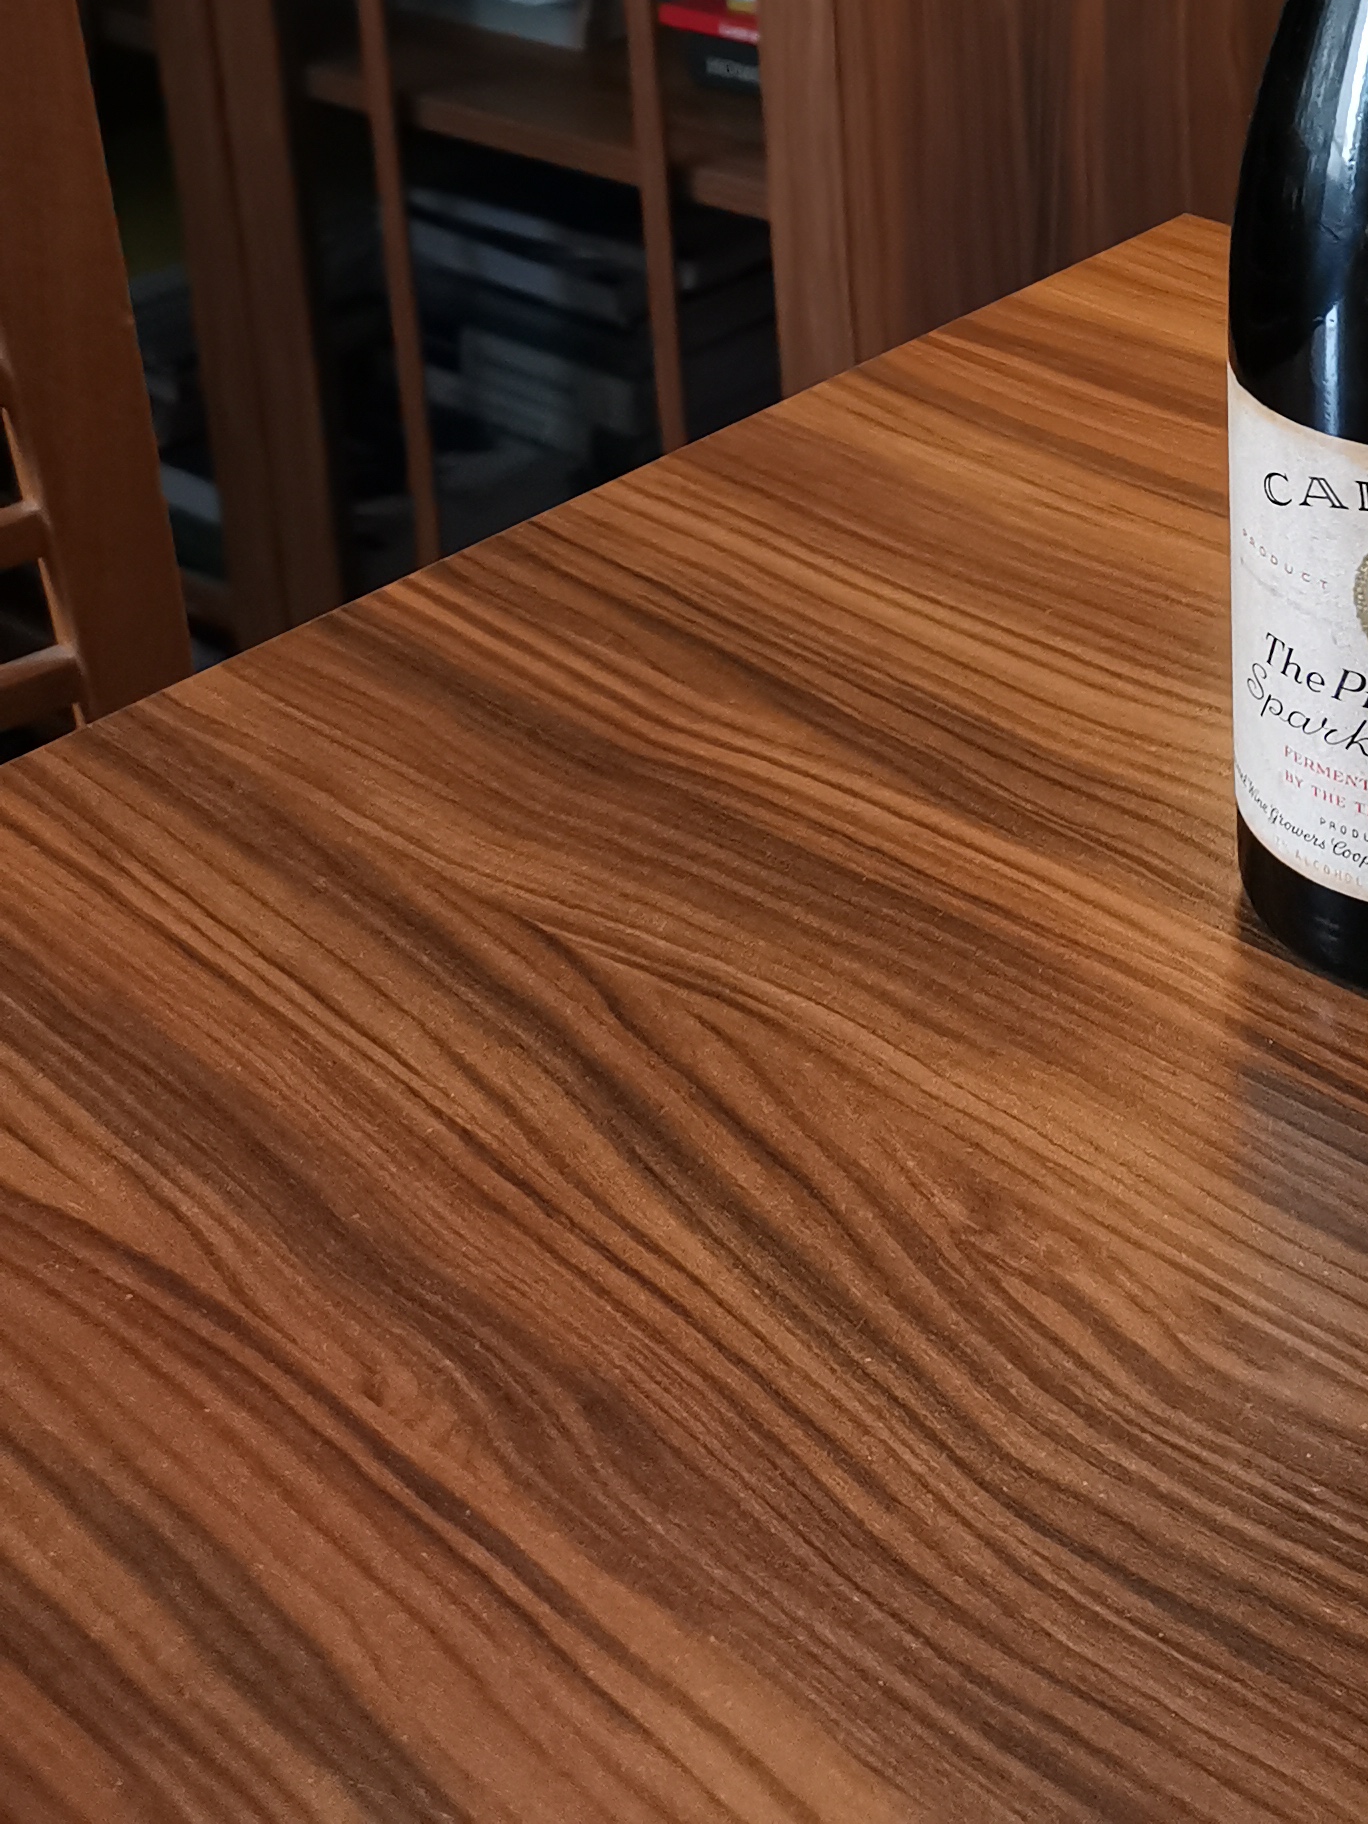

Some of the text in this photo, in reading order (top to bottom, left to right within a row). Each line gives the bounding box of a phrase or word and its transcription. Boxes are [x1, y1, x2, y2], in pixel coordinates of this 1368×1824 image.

[1241, 527, 1329, 590] PRODUCT
[1265, 631, 1326, 693] The
[1284, 769, 1304, 791] BY
[1310, 784, 1346, 809] THE
